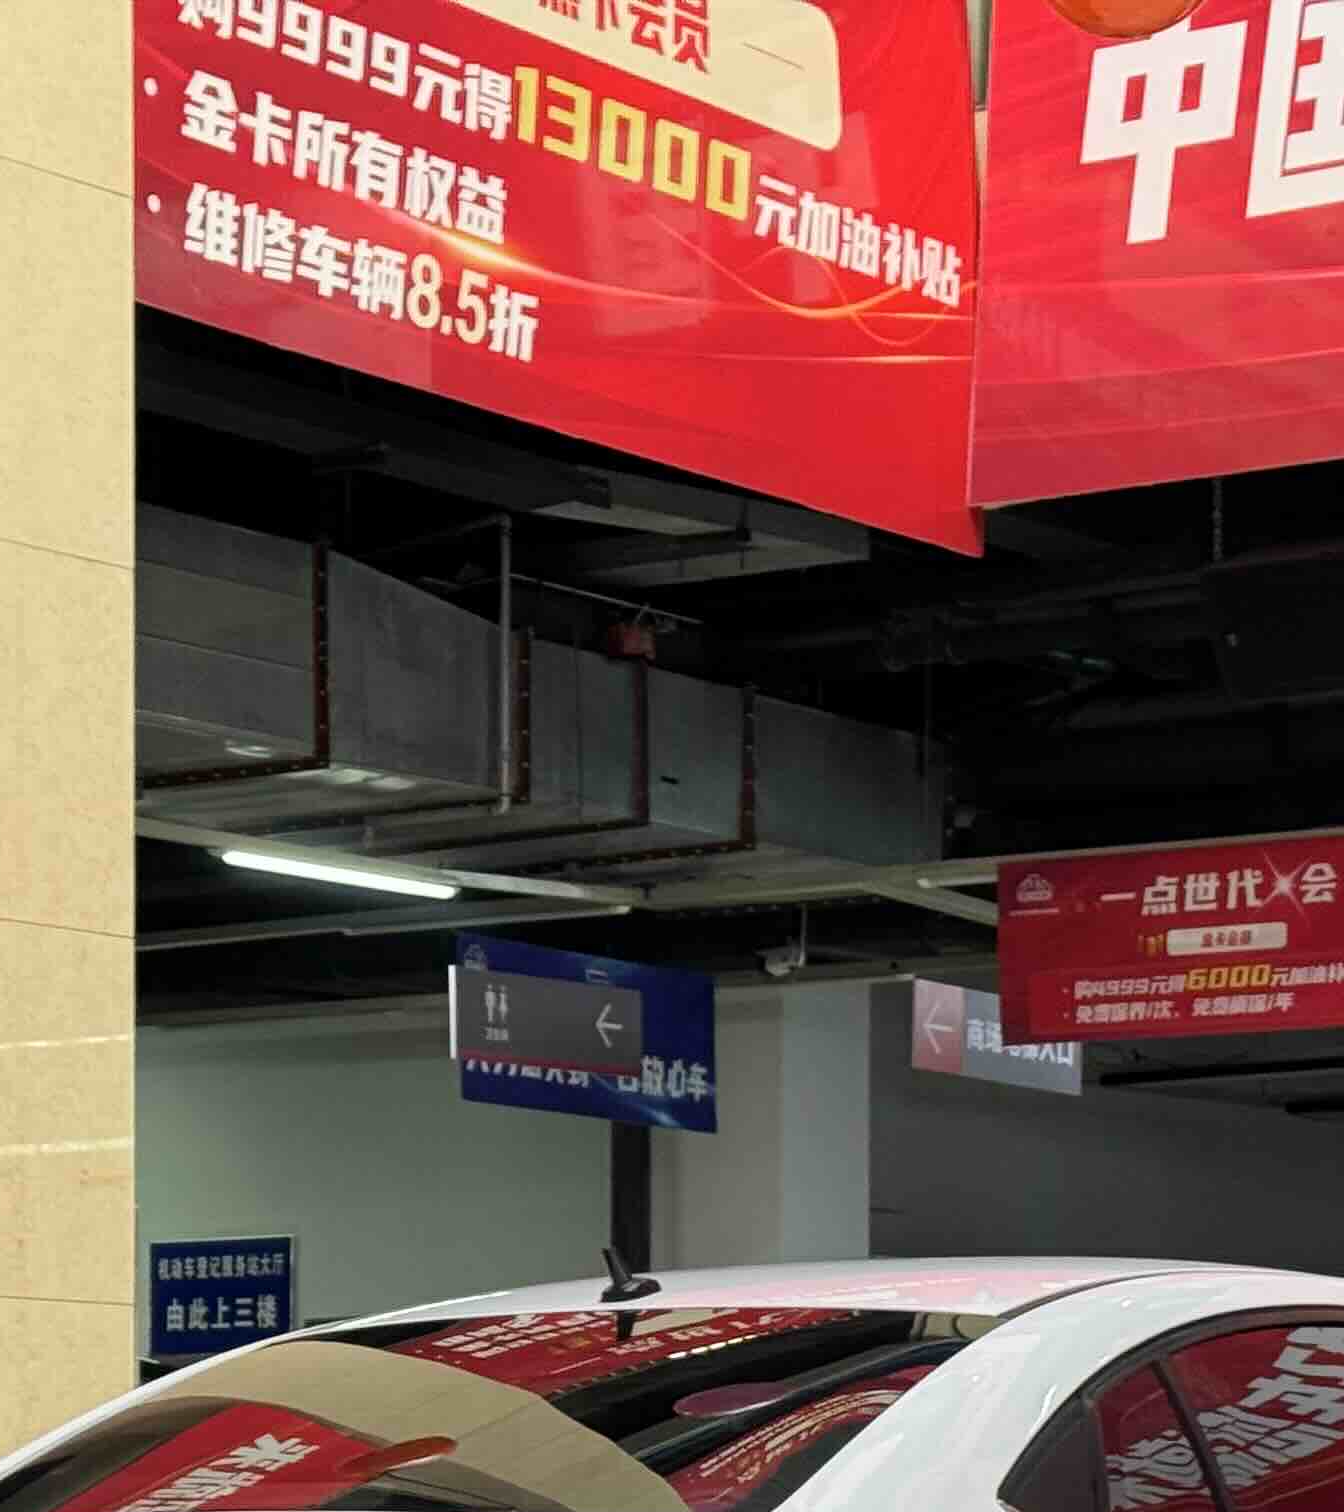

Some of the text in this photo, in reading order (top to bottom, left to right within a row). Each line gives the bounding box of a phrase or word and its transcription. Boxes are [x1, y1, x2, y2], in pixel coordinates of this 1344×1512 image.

[536, 0, 710, 74] 会员
[180, 69, 509, 246] 金卡所有权益
[184, 182, 540, 363] 维修车辆8.5折
[166, 1294, 278, 1332] 由此上三楼
